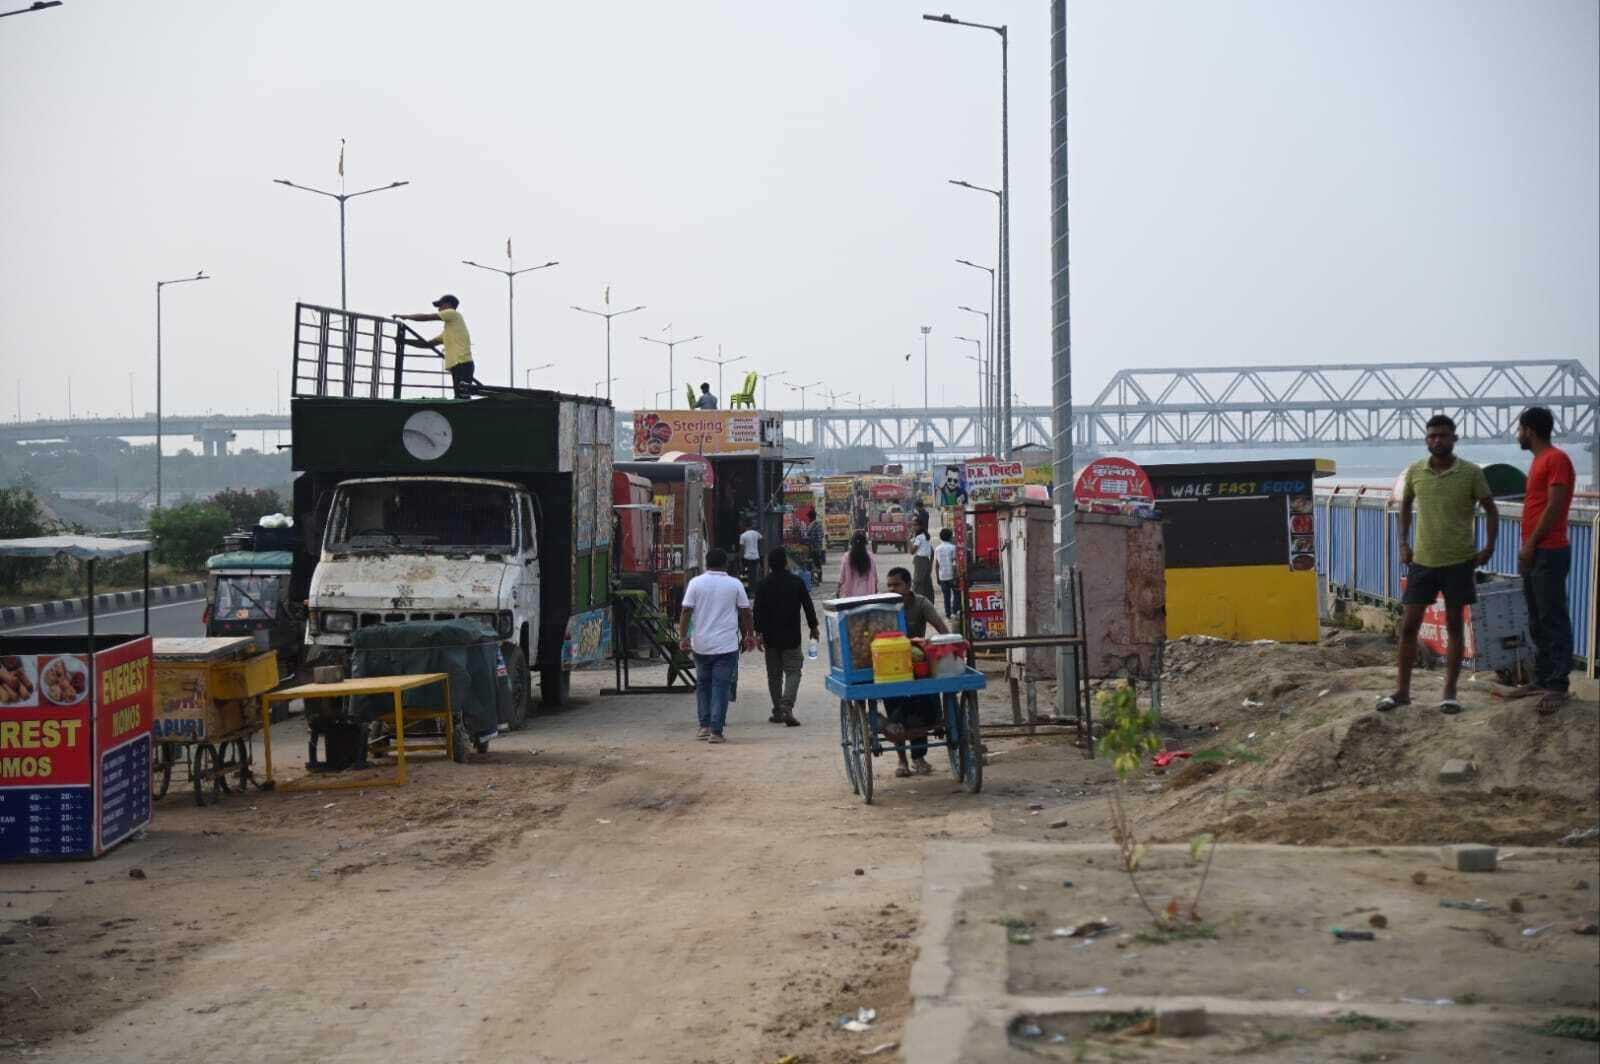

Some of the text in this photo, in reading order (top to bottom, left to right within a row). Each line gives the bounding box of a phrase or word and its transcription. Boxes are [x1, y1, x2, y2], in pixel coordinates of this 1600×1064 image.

[673, 420, 722, 432] Sterling
[684, 433, 712, 444] Cafe
[1170, 482, 1213, 497] WALE
[1218, 482, 1257, 495] FAST
[1262, 480, 1305, 493] FOOD
[102, 656, 149, 705] EVEREST
[111, 704, 141, 737] MOMOS
[0, 720, 82, 749] REST
[0, 756, 52, 777] MOS
